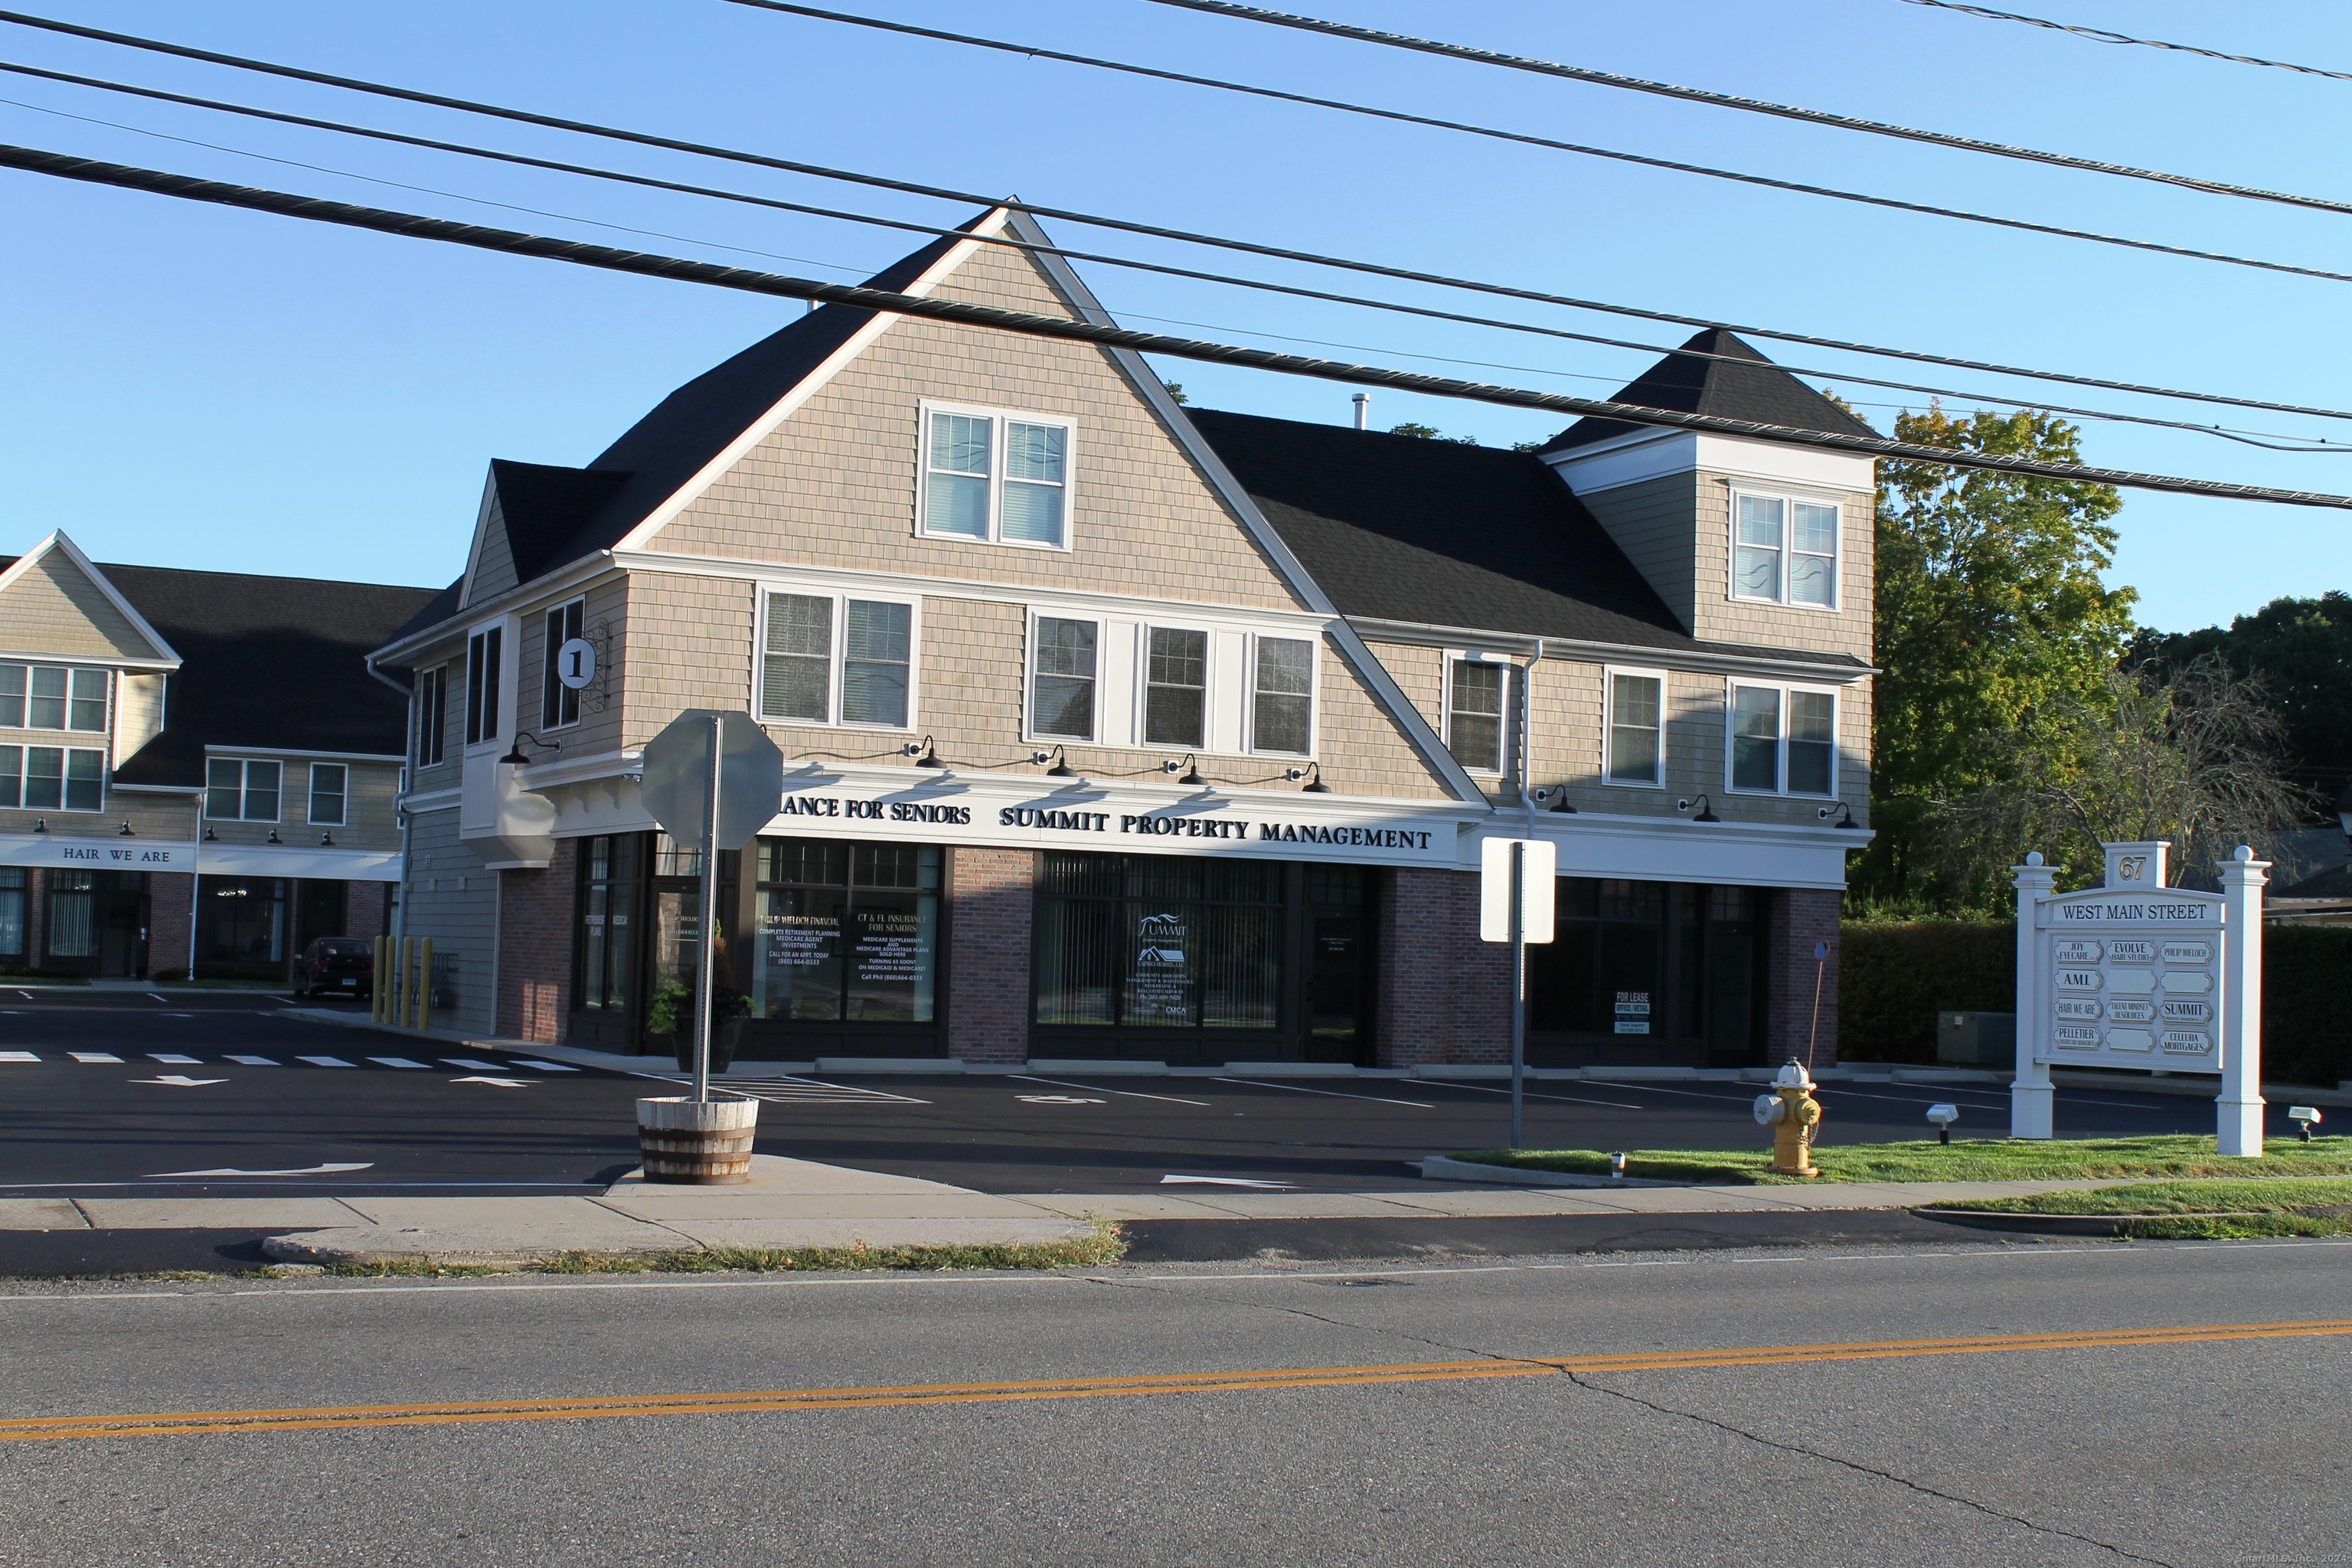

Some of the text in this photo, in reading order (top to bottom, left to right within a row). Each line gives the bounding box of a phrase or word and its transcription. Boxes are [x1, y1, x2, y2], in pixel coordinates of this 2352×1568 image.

[568, 649, 584, 678] 1
[779, 795, 971, 825] ANCE FOR SENIORS
[1000, 807, 1432, 849] SUMMIT PROPERTY MANAGEMENT
[64, 848, 170, 862] HAIR WE ARE
[2119, 856, 2147, 880] 67
[2063, 904, 2207, 920] WEST MAIN STREET
[782, 916, 808, 925] WIELOCH
[810, 917, 839, 926] FINANCIAL
[1138, 920, 1187, 936] SUMMIT
[2070, 942, 2085, 951] JOY
[2115, 942, 2146, 953] EVOLVE
[2164, 948, 2206, 957] PHILIP WIELOCH
[2064, 974, 2090, 985] A.M.I.
[1617, 992, 1648, 1002] FOR LEASE
[2058, 1003, 2096, 1014] HAIR WE ARE
[2128, 1002, 2148, 1011] MINDSET
[2164, 1003, 2203, 1015] SUMMIT
[2060, 1028, 2094, 1039] PELLETIER
[2170, 1033, 2198, 1042] CELLURA
[2164, 1042, 2204, 1051] MORTGAGES
